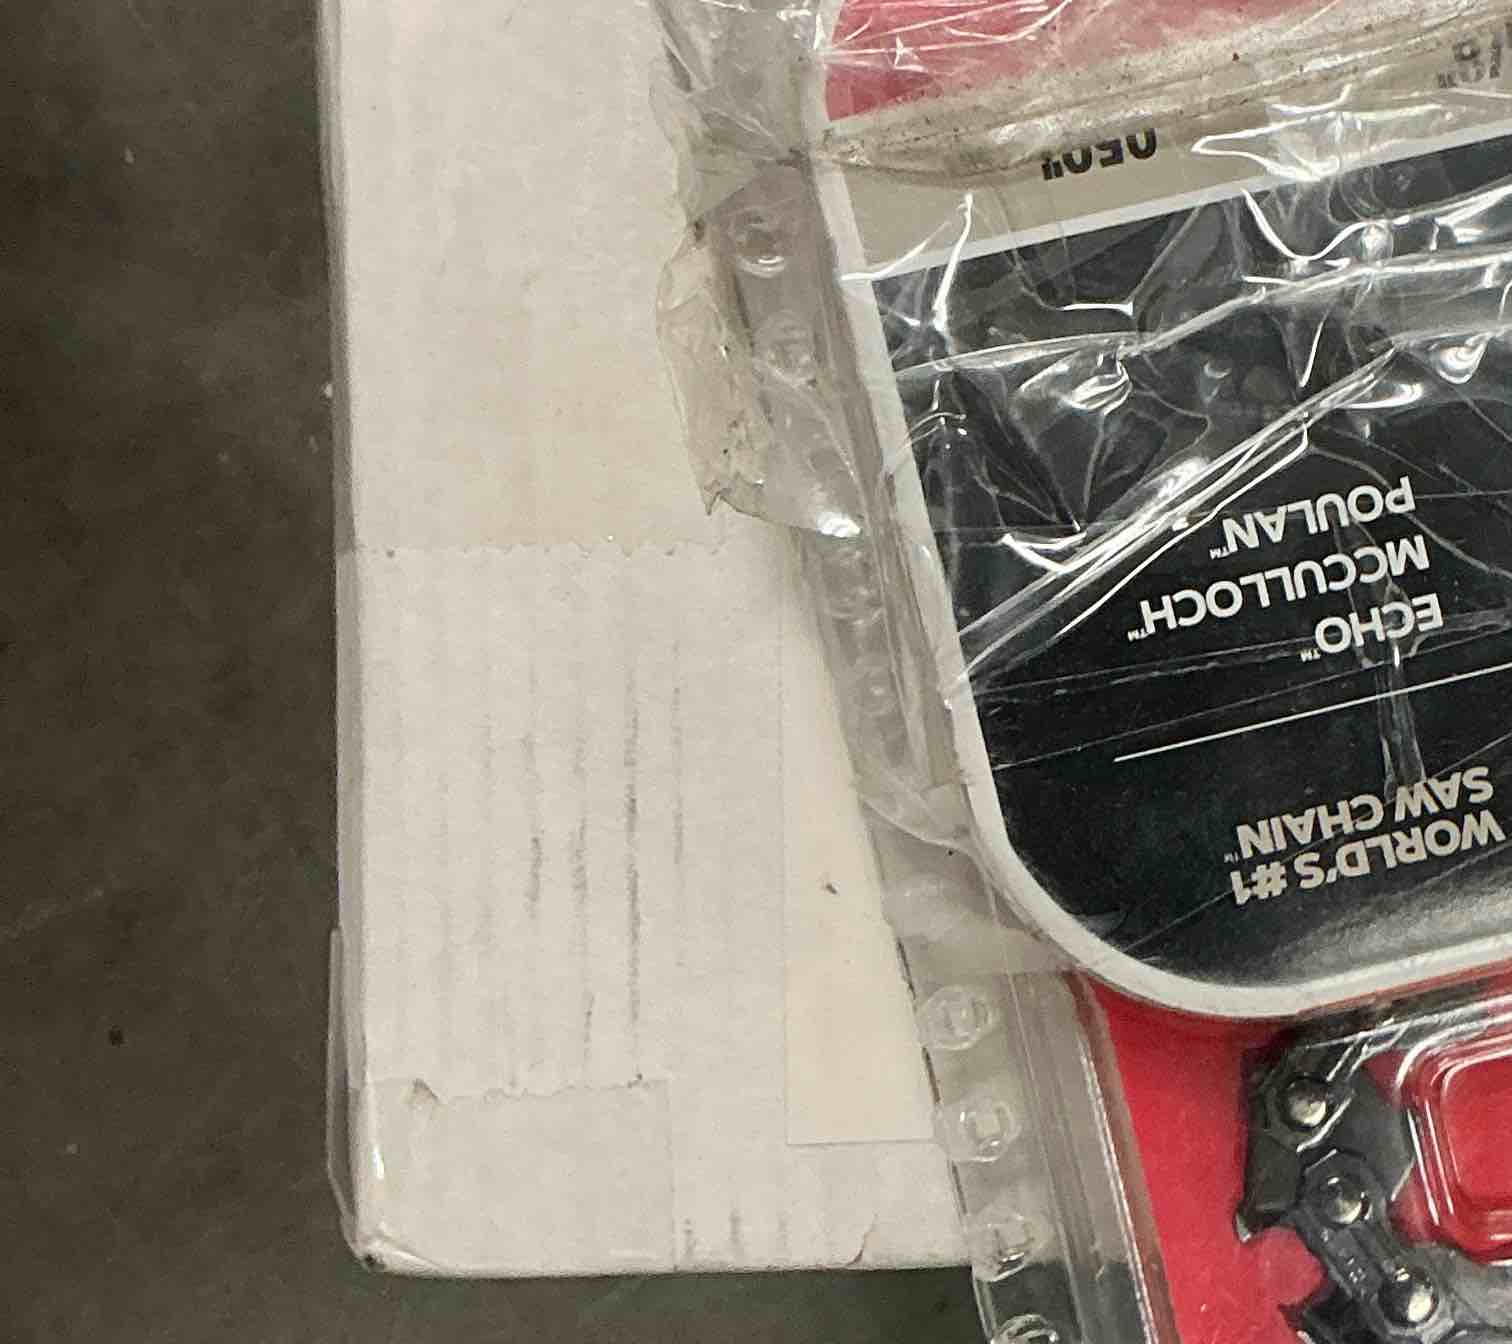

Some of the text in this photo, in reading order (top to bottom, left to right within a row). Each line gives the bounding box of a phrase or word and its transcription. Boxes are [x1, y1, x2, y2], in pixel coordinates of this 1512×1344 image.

[1394, 764, 1495, 821] SAW
[1229, 808, 1507, 906] WORLD'S #1
